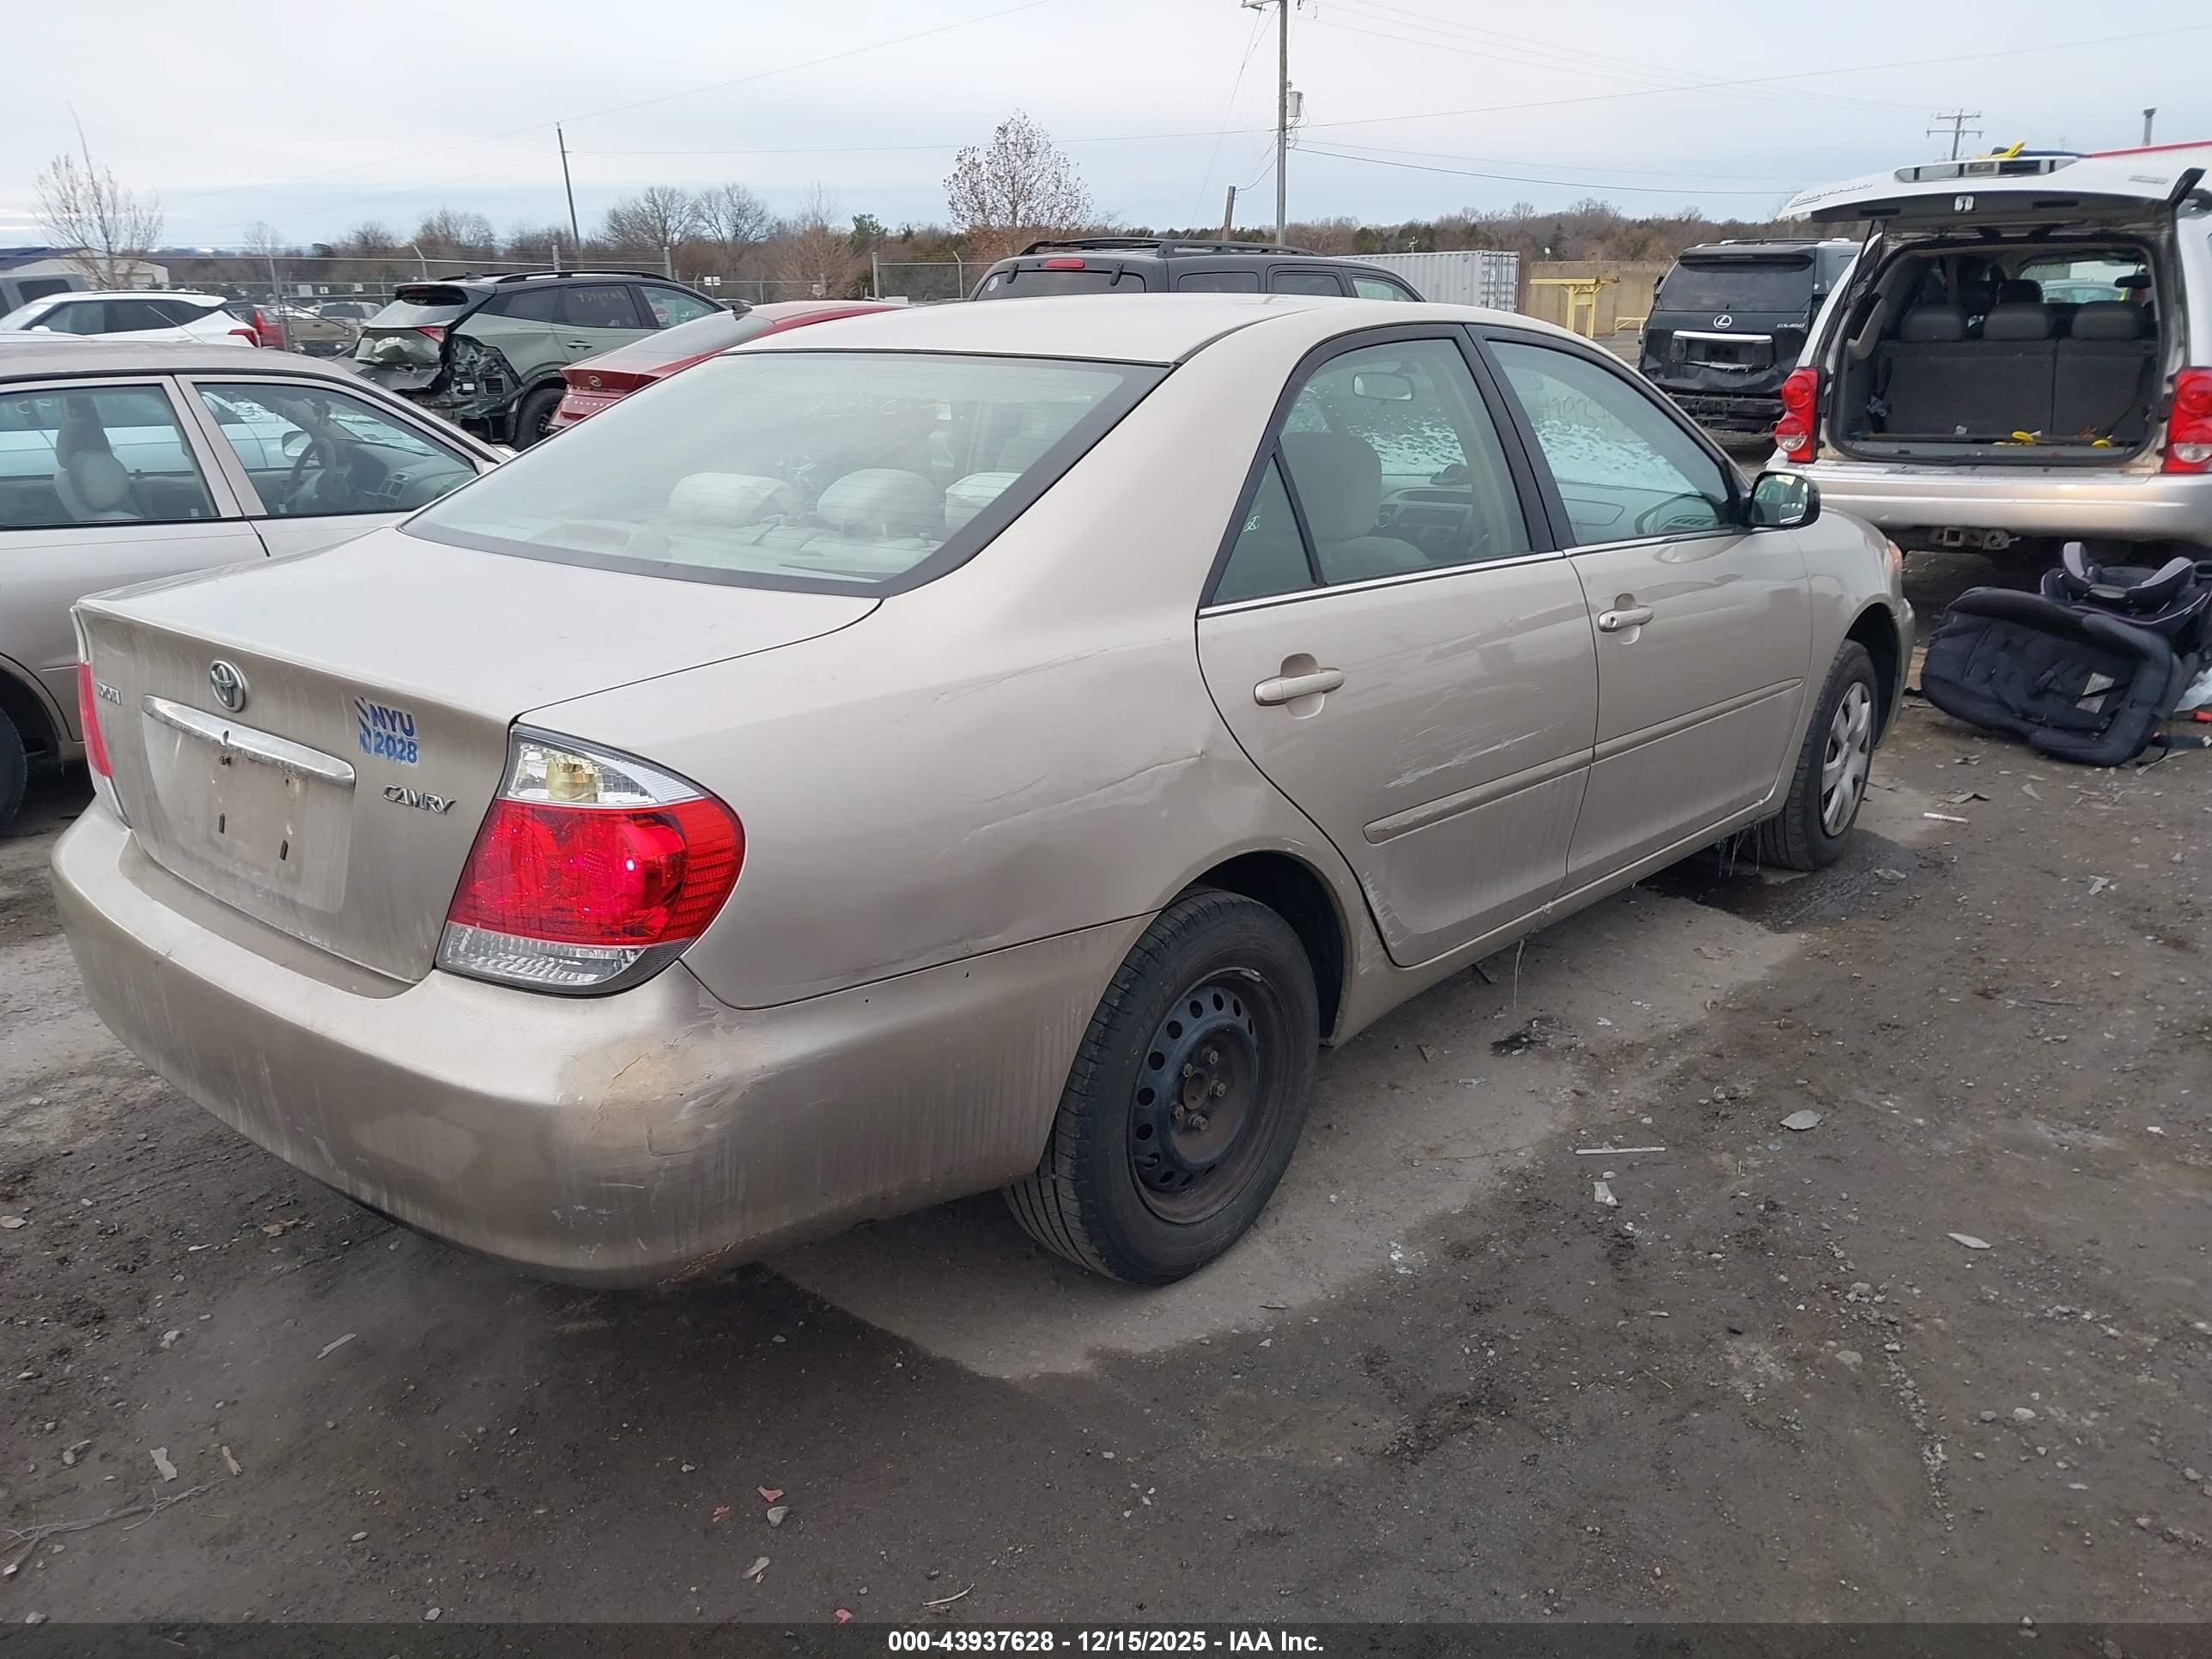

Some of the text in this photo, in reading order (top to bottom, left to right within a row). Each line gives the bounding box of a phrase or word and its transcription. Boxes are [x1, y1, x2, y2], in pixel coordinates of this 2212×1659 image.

[369, 702, 415, 738] NYU
[374, 731, 417, 764] 2028
[383, 783, 457, 816] CAMRY
